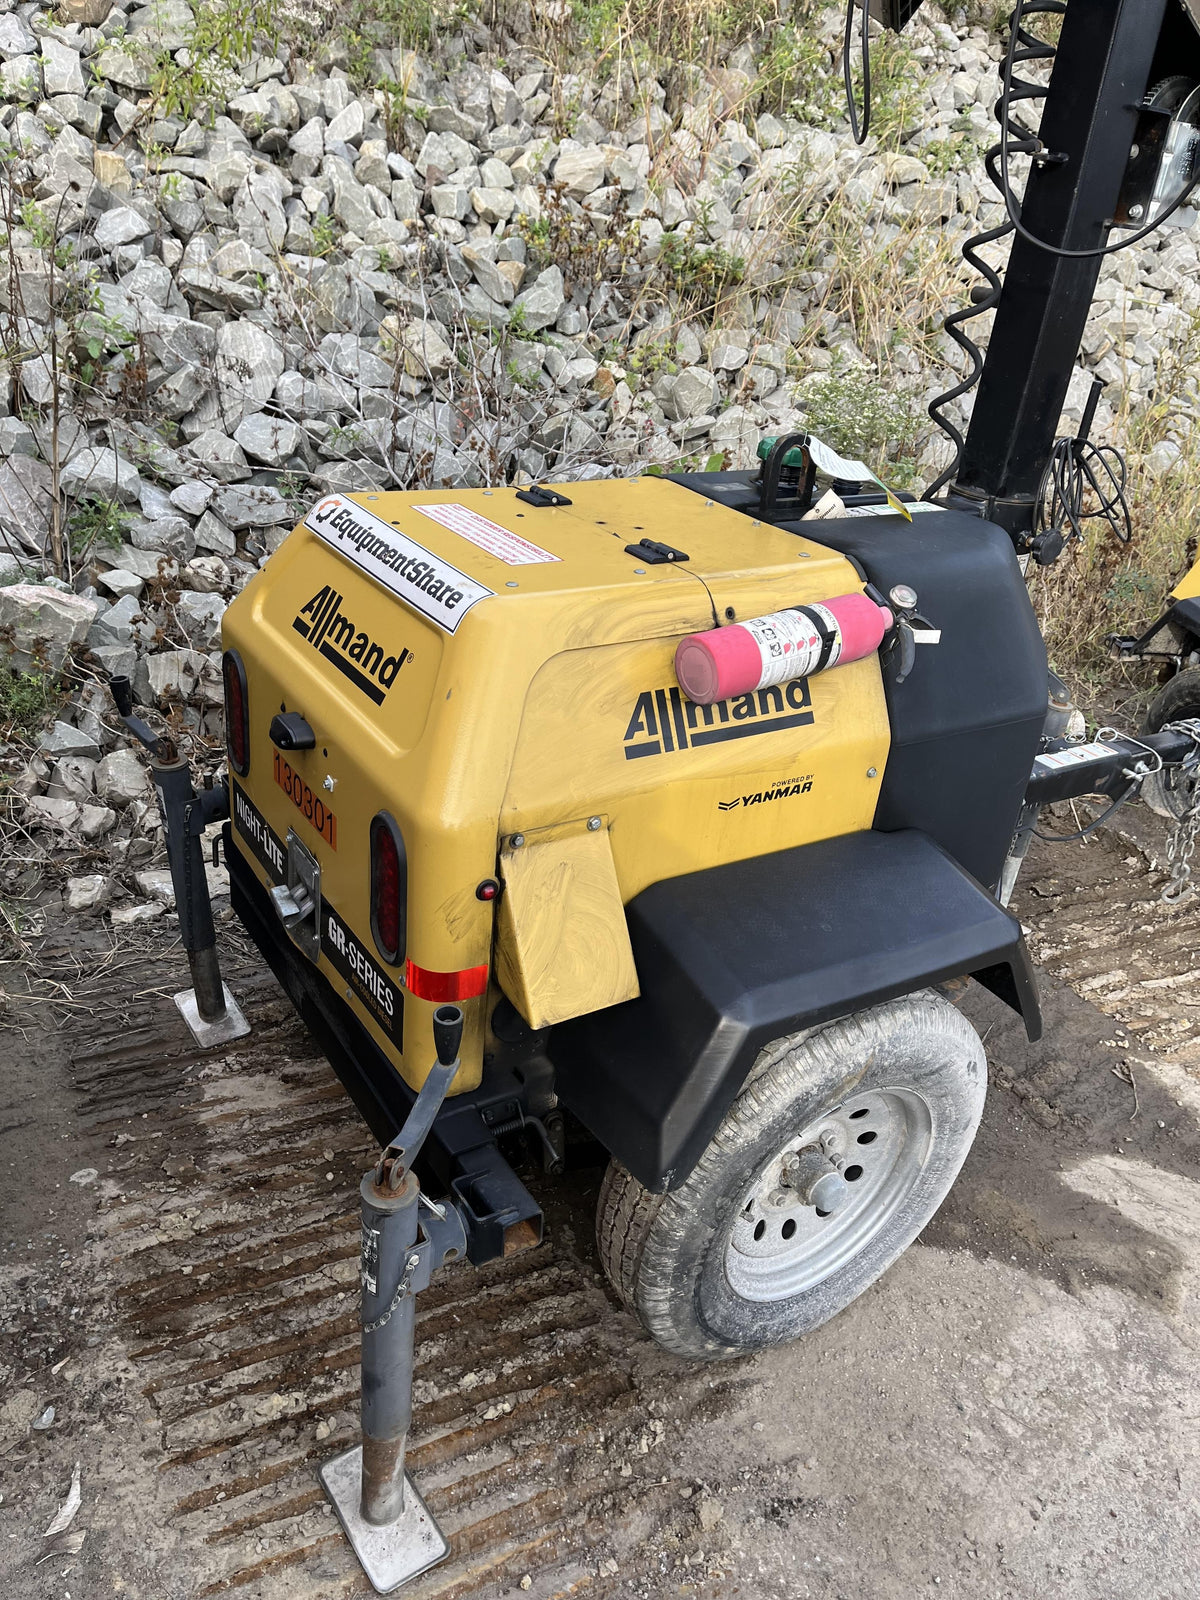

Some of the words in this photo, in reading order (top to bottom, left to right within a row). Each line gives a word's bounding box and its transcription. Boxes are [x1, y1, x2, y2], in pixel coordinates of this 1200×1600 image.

[330, 508, 464, 610] EquipmentShare
[275, 753, 334, 844] 130301
[742, 781, 813, 807] YANMAR
[771, 775, 805, 788] POWERED
[236, 793, 283, 875] NIGHT-LITE
[328, 916, 393, 1016] GR-SERIES
